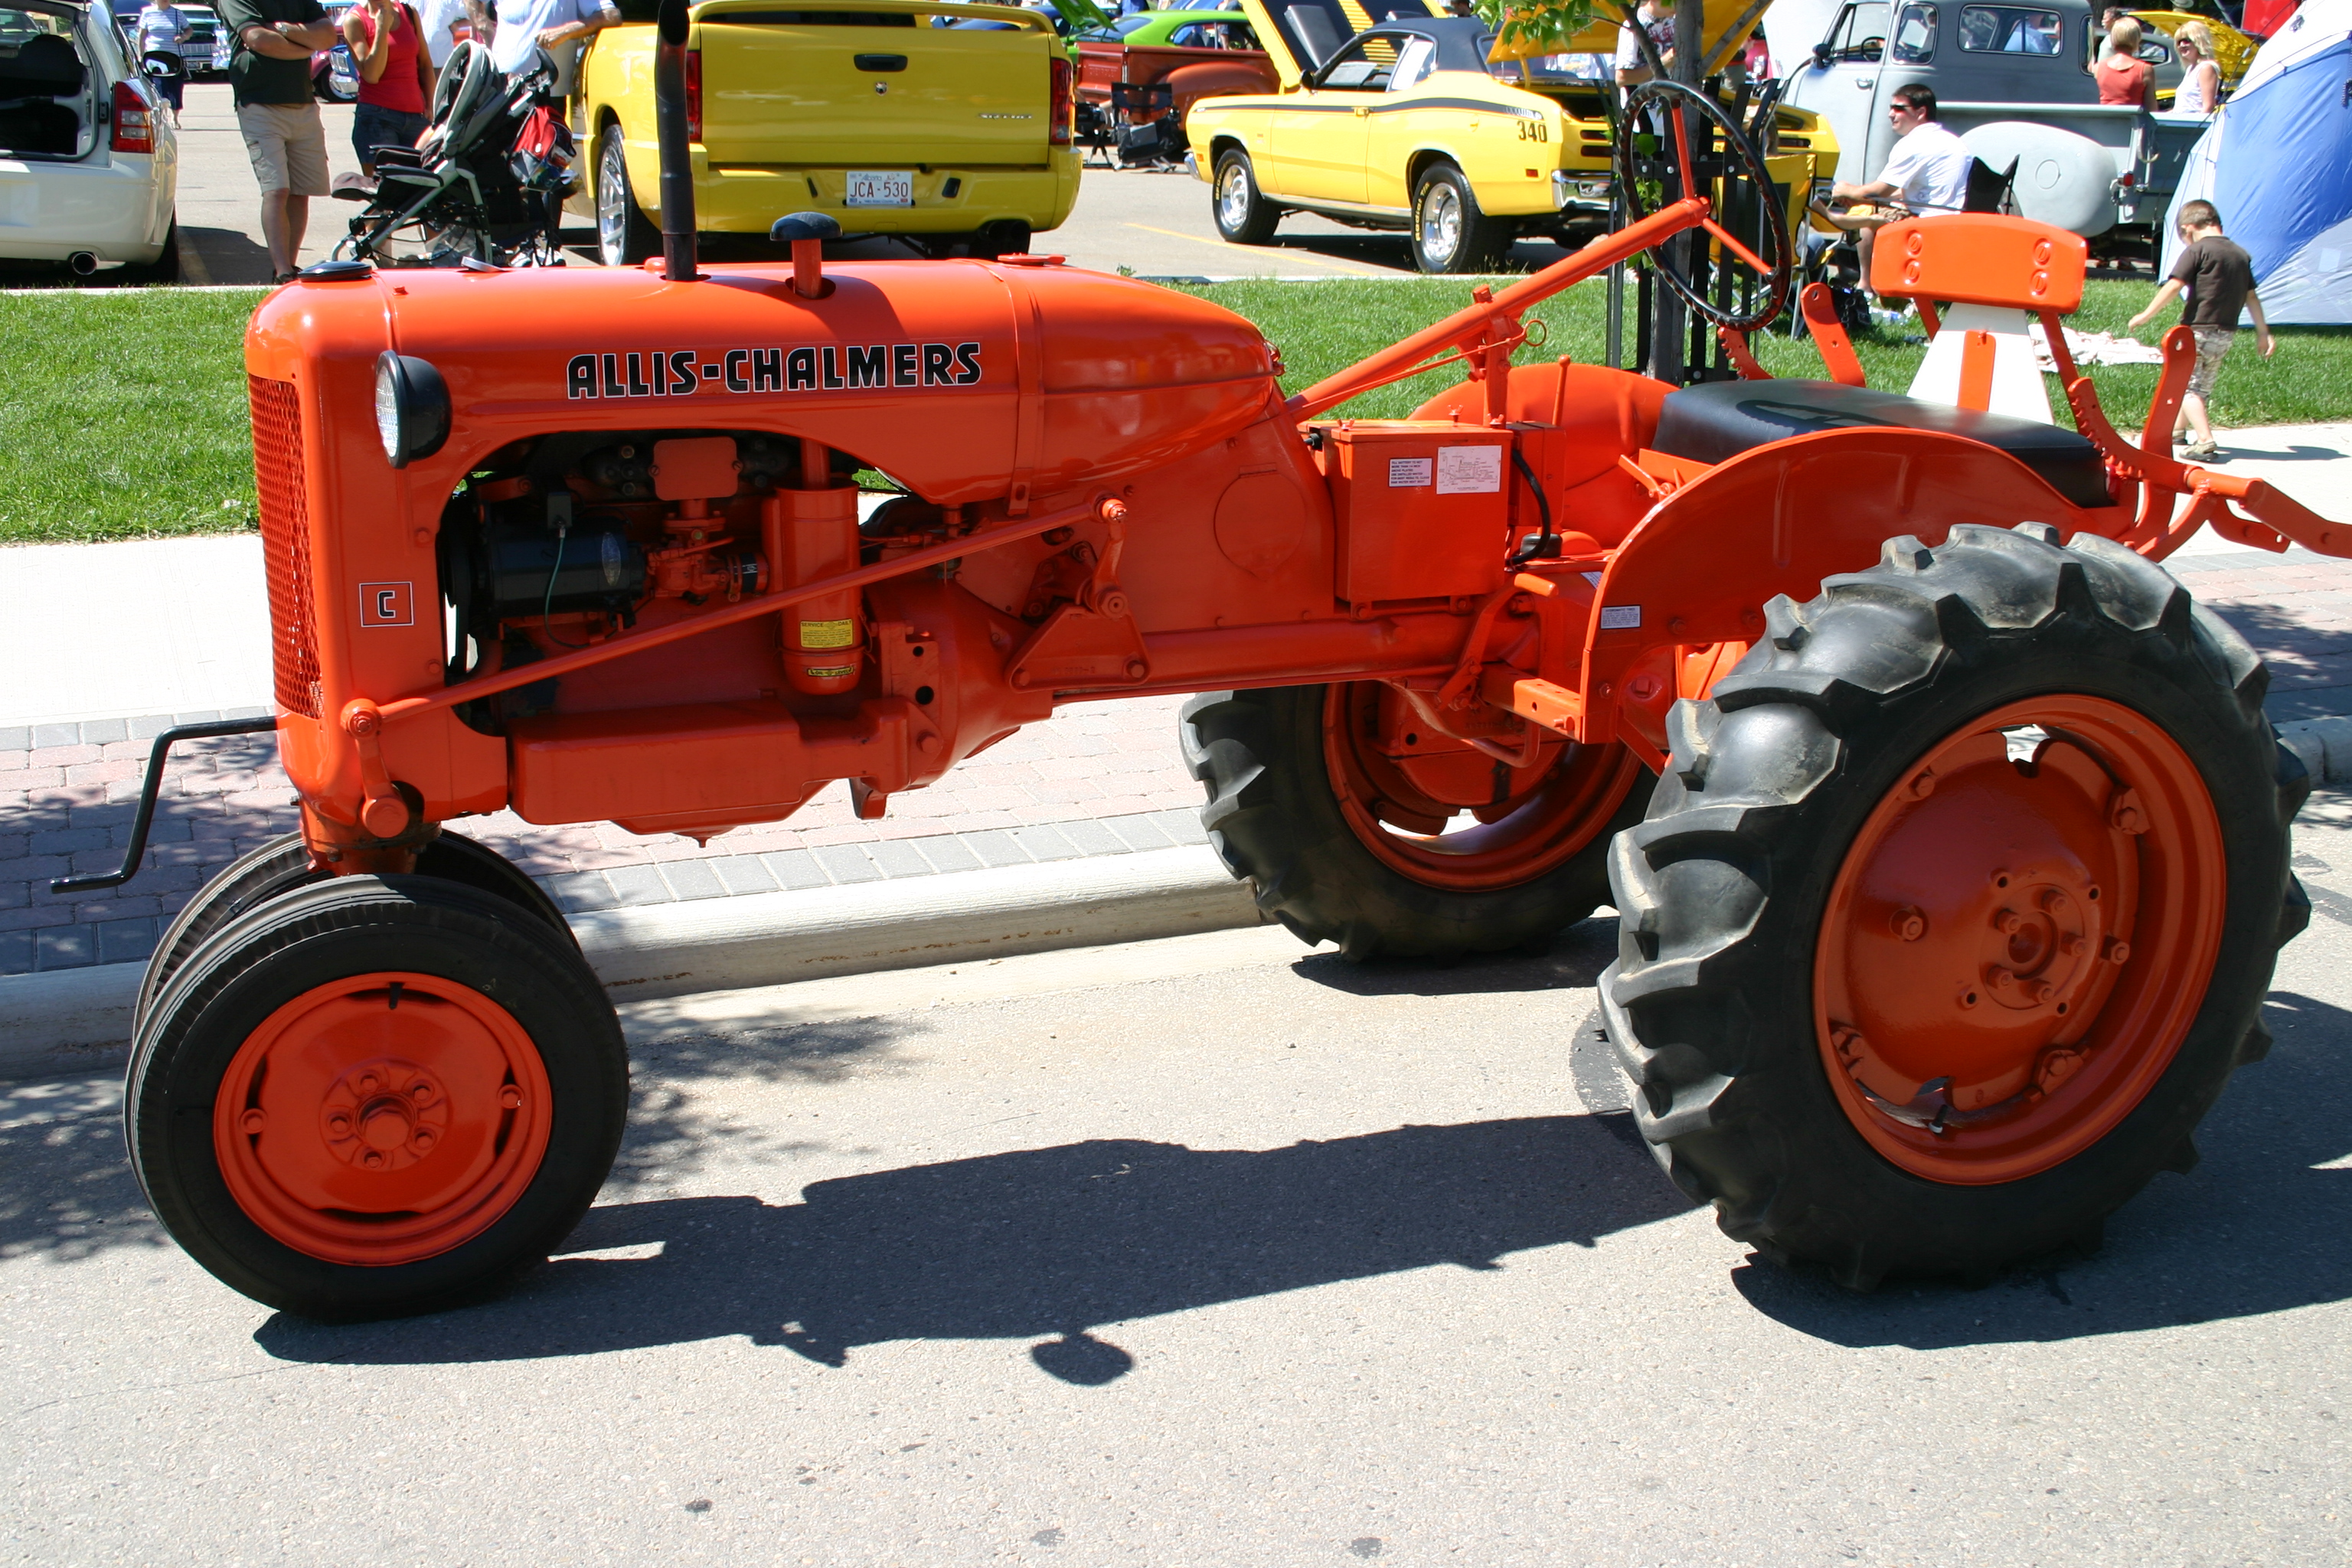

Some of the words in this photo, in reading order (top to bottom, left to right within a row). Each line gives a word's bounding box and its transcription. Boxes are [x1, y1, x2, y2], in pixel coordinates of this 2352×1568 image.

[1517, 119, 1547, 143] 340
[850, 181, 909, 198] JCA-530
[567, 341, 982, 400] ALLIS-CHALMERS
[377, 590, 396, 619] C
